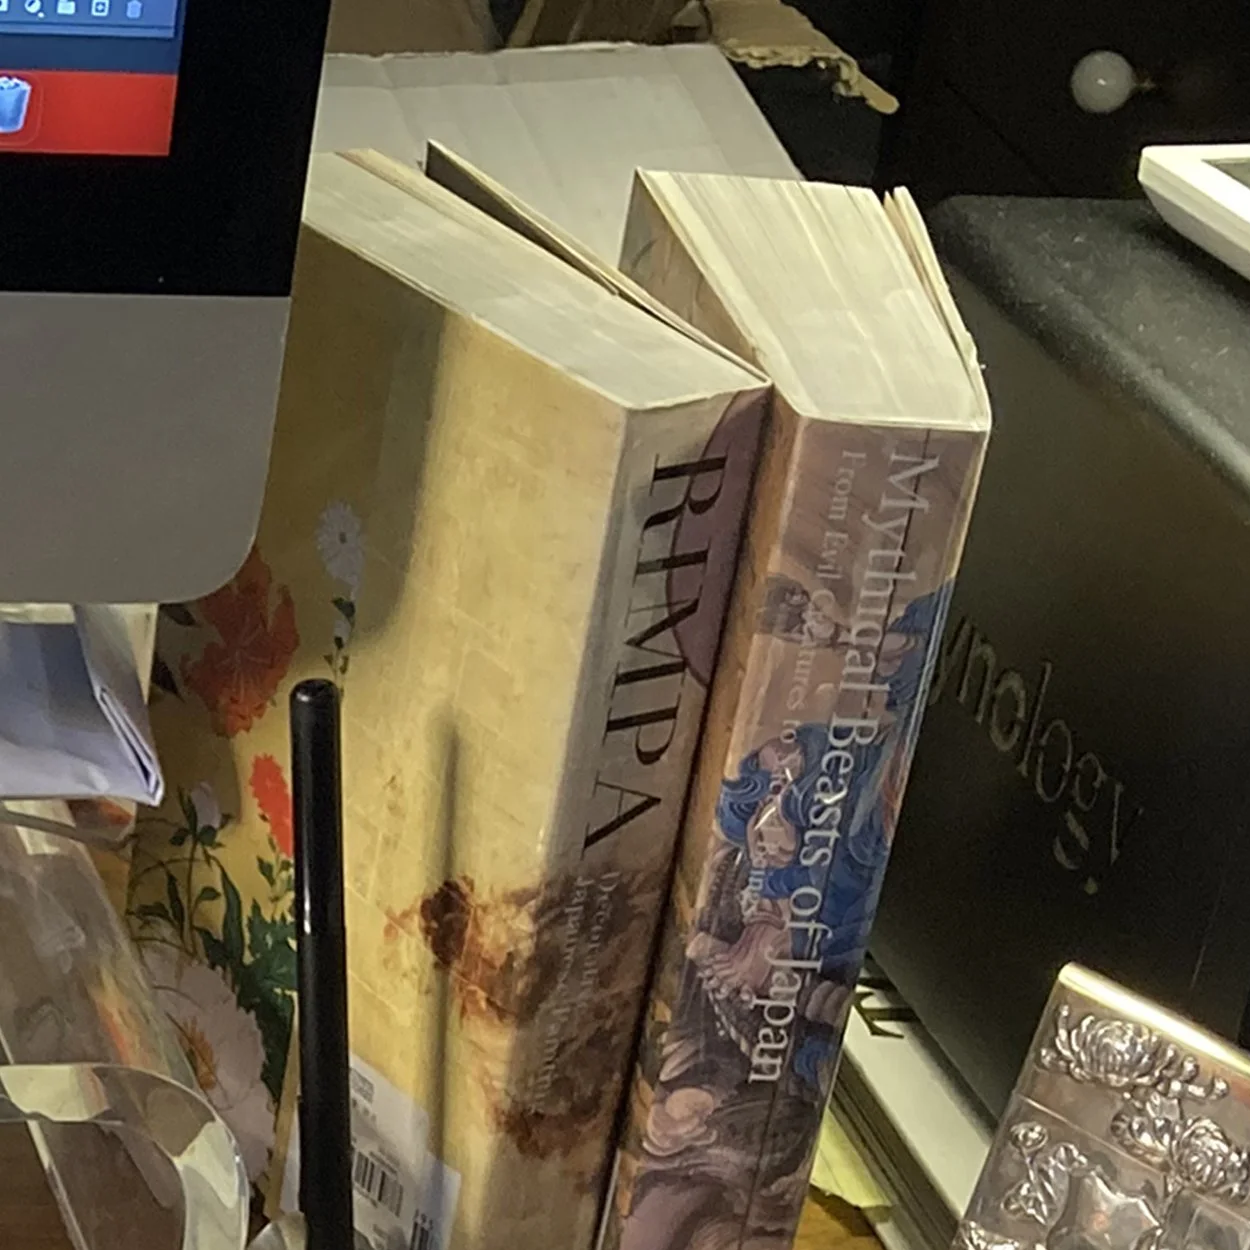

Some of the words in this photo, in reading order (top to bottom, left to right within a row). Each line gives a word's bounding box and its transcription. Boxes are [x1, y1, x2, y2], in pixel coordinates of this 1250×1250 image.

[817, 531, 849, 580] Evil
[828, 450, 867, 521] From
[839, 453, 940, 693] Mythical
[582, 453, 728, 860] RIMPA
[799, 712, 880, 868] Beasts
[789, 885, 833, 945] of
[748, 942, 823, 1085] Japan
